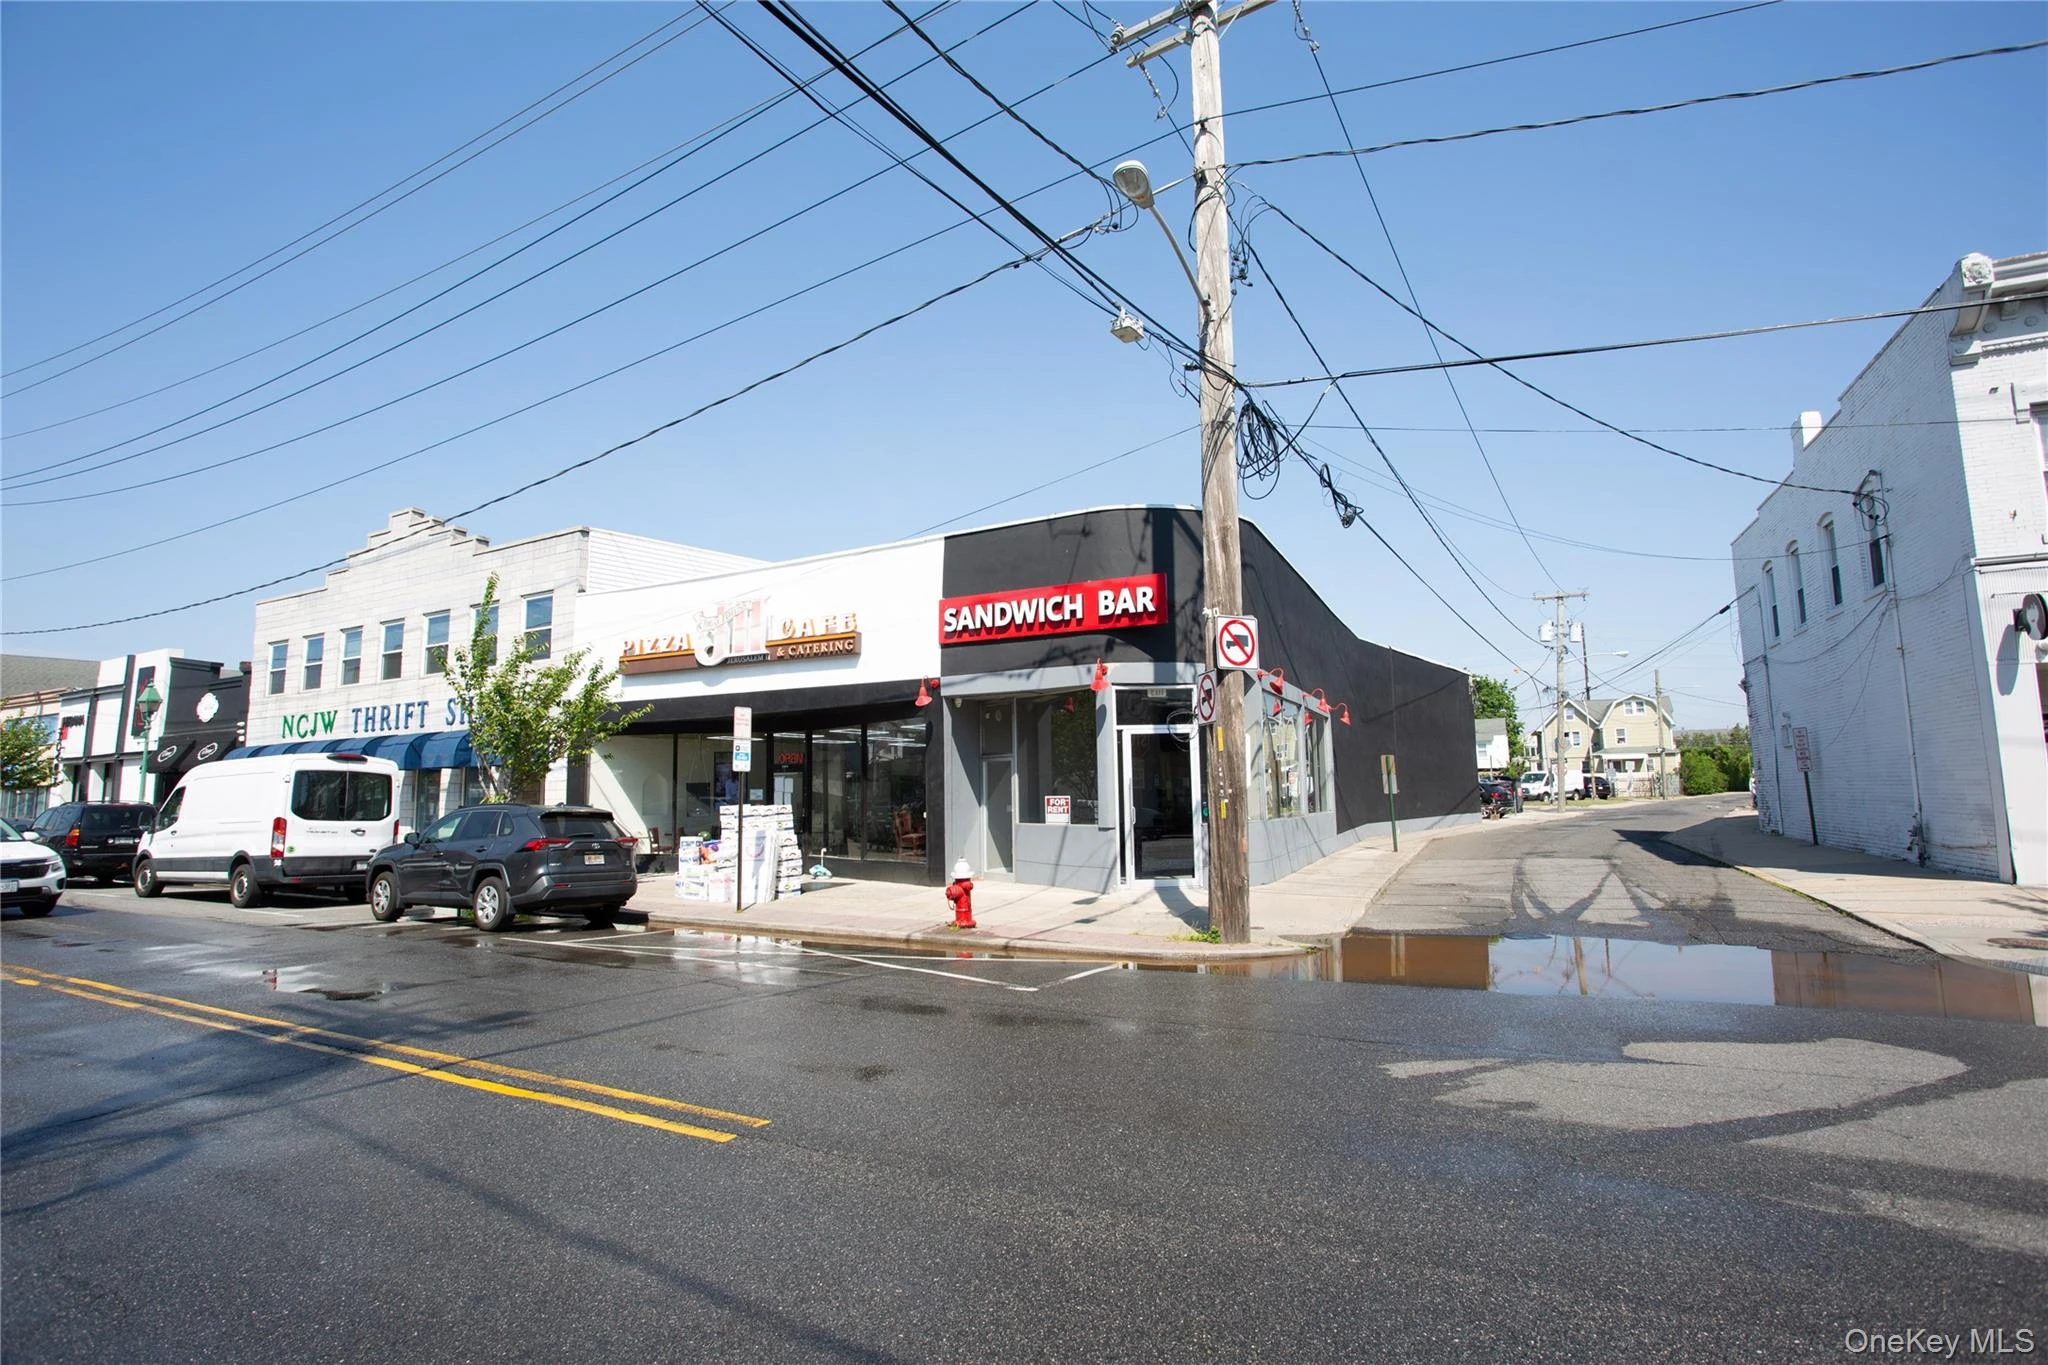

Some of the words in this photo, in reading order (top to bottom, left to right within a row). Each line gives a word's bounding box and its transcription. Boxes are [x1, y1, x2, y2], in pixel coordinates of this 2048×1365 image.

[943, 593, 1084, 633] SANDWICH
[1098, 586, 1156, 616] BAR
[621, 633, 692, 656] PIZZA
[775, 647, 785, 658] &
[787, 640, 855, 657] CATERING
[726, 654, 764, 665] JERUSALEM
[281, 710, 338, 739] NCJW
[351, 699, 429, 734] THRIFT
[778, 751, 804, 765] OPEN
[1047, 806, 1069, 814] RENT
[1049, 798, 1066, 807] FOR
